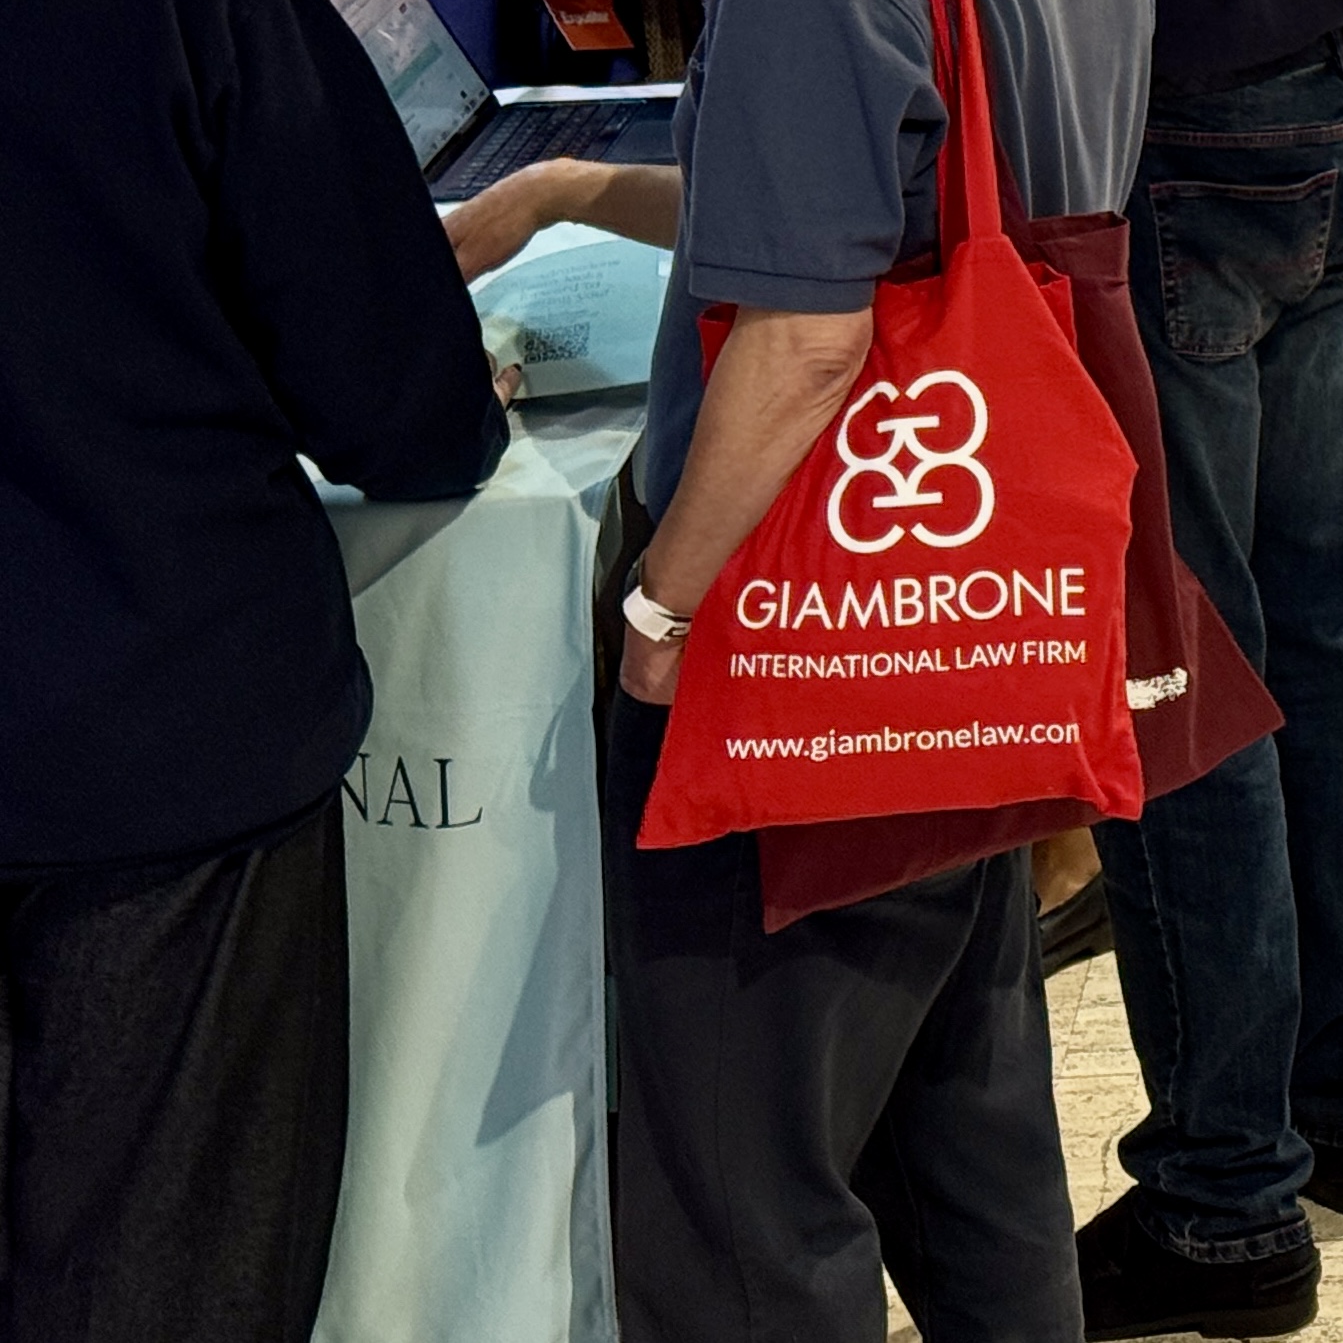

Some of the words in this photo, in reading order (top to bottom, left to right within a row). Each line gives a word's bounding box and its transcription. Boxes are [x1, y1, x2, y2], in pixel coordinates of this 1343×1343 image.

[736, 568, 1086, 630] GIAMBRONE
[730, 649, 950, 680] INTERNATIONAL
[956, 642, 1017, 670] LAW
[1023, 640, 1087, 665] FIRM
